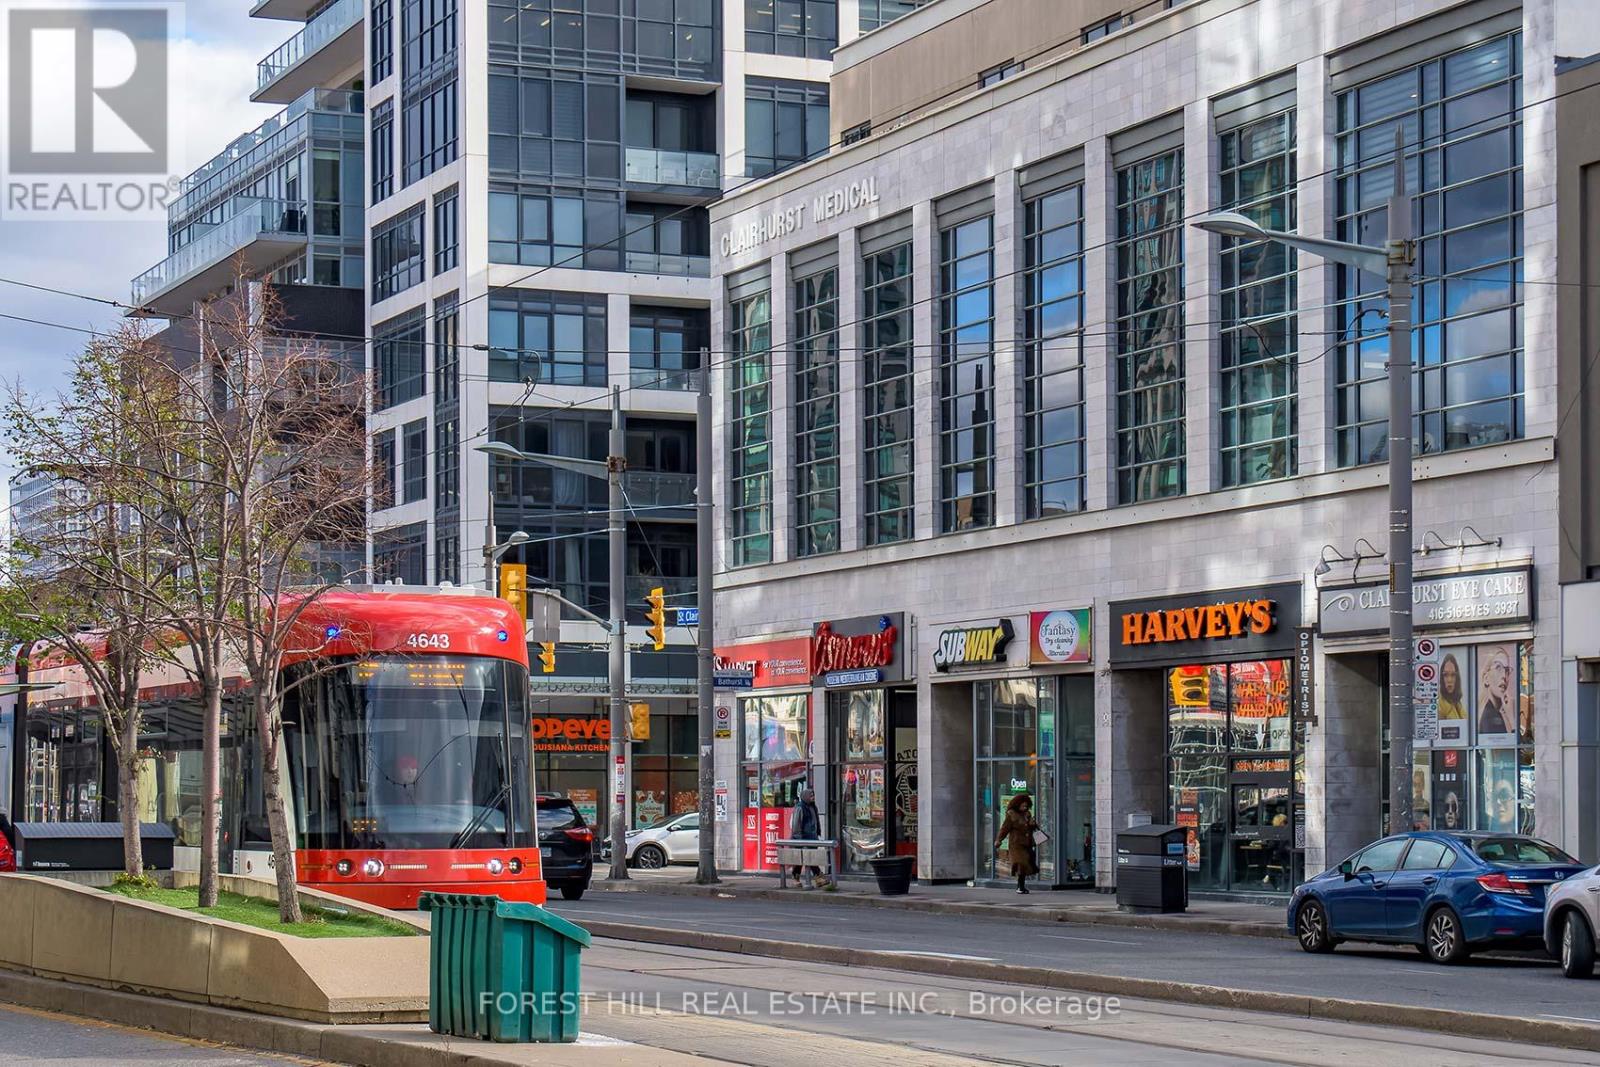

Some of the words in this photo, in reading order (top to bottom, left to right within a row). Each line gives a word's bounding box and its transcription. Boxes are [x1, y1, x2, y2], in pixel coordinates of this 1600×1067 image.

[720, 204, 806, 257] CLAIRHURST
[813, 175, 880, 223] MEDICAL
[1359, 583, 1447, 609] CLAIURST
[1452, 576, 1480, 598] EYE
[1484, 573, 1525, 597] CARE
[1495, 600, 1519, 615] 3937
[1121, 599, 1274, 645] HARVEY'S
[1040, 623, 1076, 638] Fantasy
[407, 633, 450, 649] 4643
[934, 625, 1004, 665] SUBWAY
[718, 678, 744, 686] Bathurst
[1299, 632, 1310, 717] OPTOMETRIST
[1234, 701, 1287, 718] WINDOW
[533, 744, 573, 752] OUISIANA
[1011, 778, 1027, 789] Open
